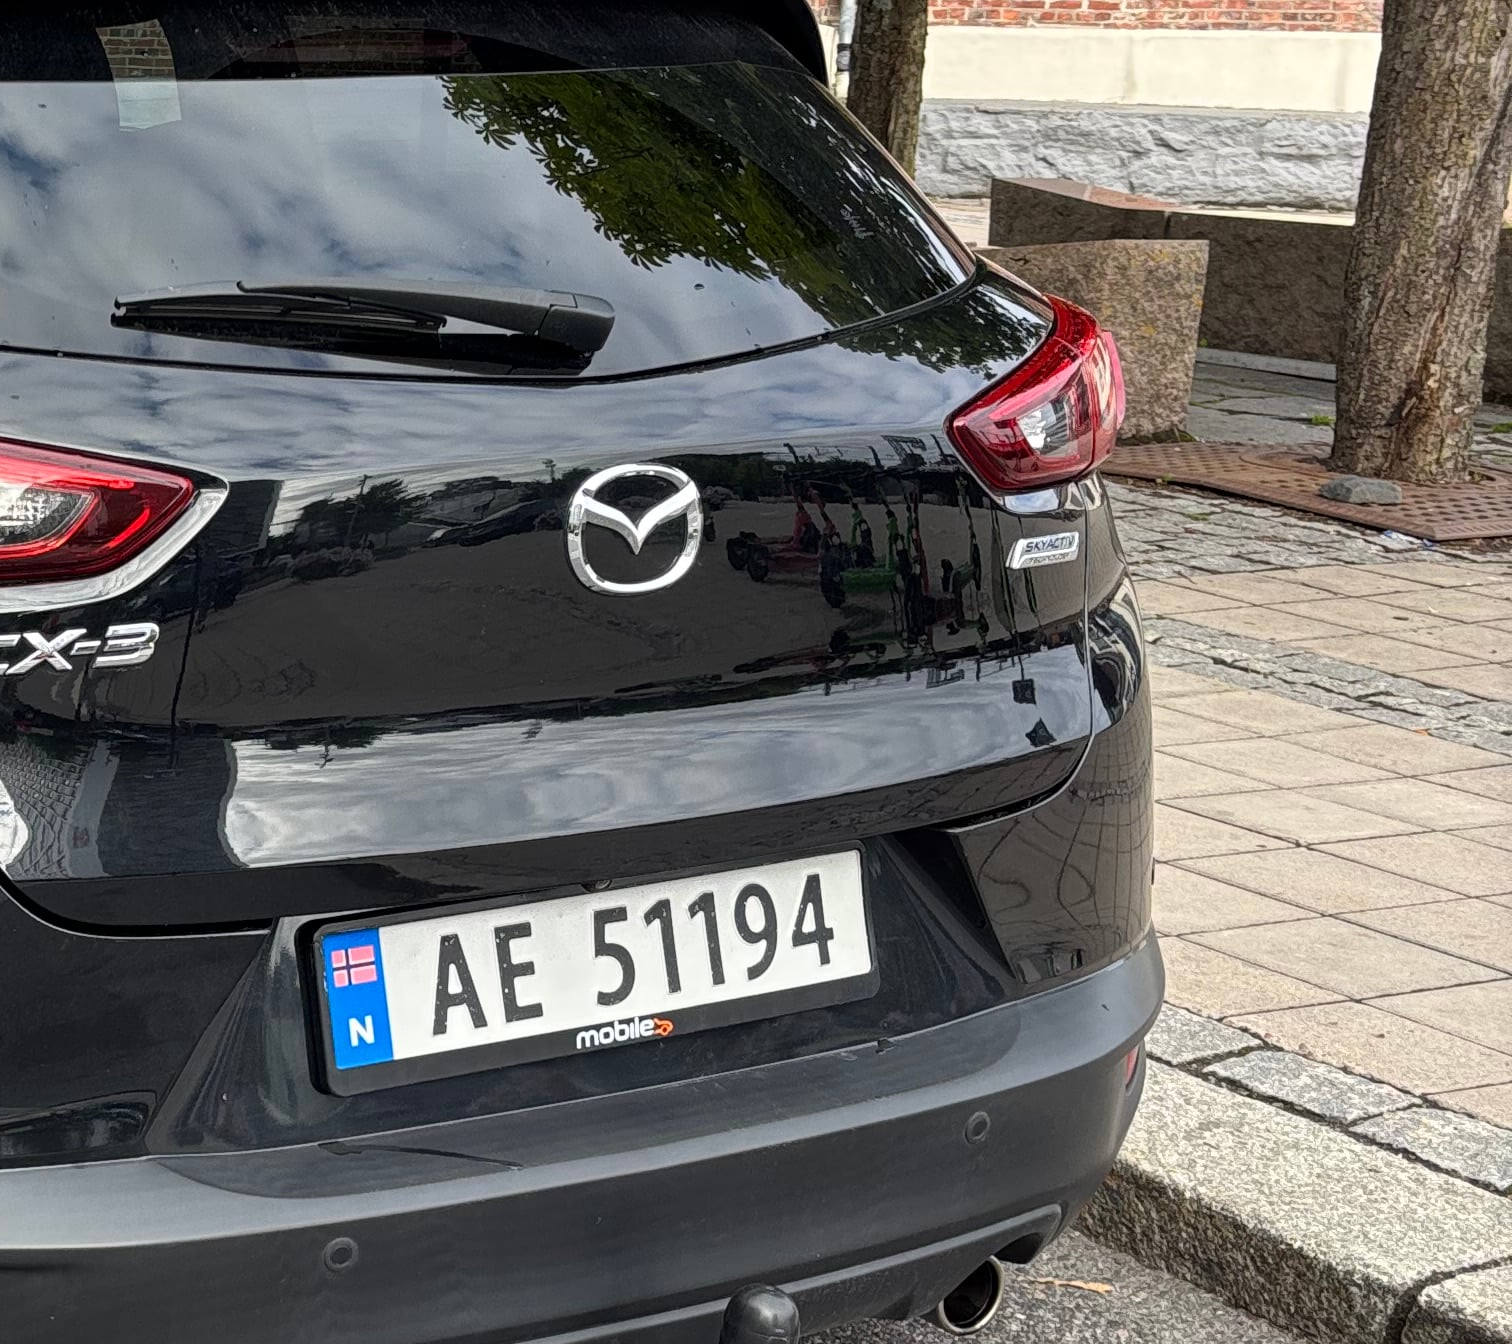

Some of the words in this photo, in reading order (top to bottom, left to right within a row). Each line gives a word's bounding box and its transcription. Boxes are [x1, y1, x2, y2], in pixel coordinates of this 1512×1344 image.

[1025, 535, 1076, 553] SKYACTIV
[432, 921, 544, 1036] AE
[592, 873, 835, 1006] 51194
[348, 1014, 375, 1047] N
[576, 1017, 655, 1050] mobile
